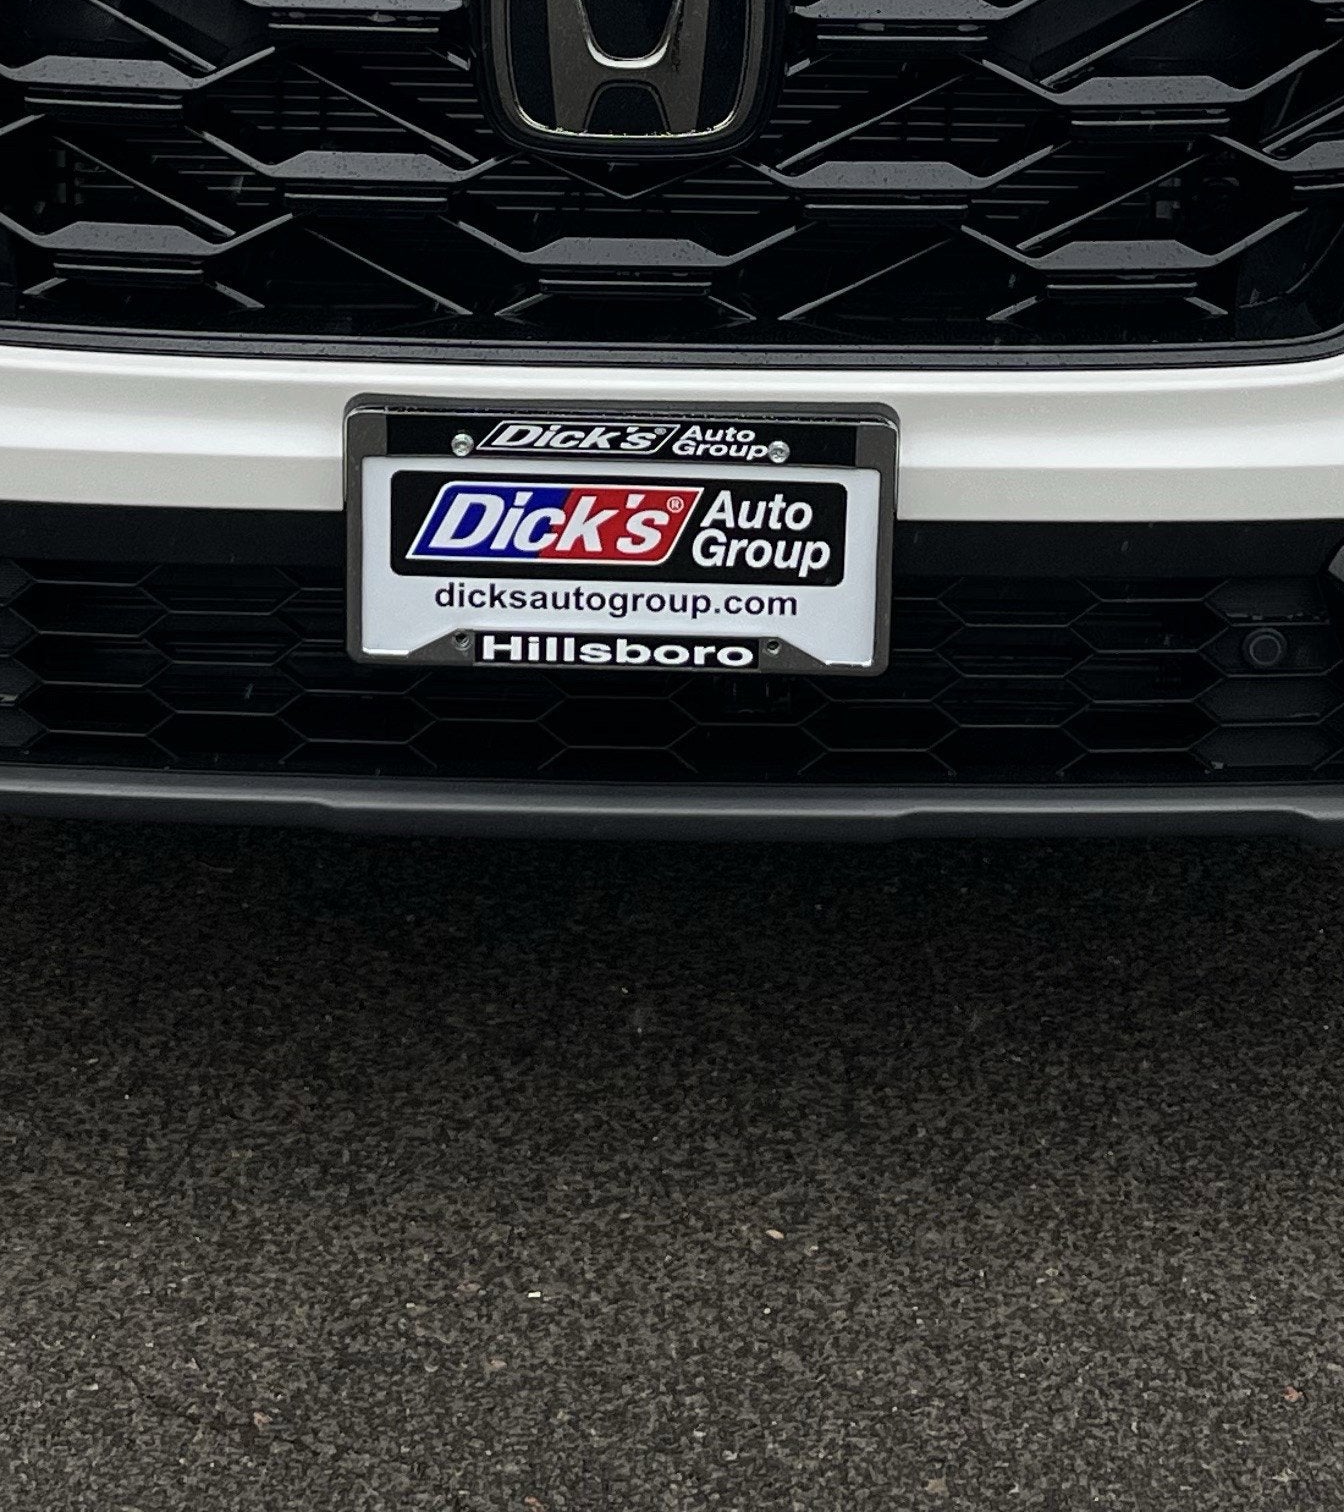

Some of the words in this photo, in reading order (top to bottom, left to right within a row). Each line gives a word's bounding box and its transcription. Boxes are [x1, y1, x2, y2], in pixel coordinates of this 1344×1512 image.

[671, 440, 768, 460] Group
[680, 425, 756, 442] Auto
[701, 490, 813, 531] Auto
[693, 530, 831, 577] Group
[434, 583, 798, 618] dicksautogroup.com
[482, 636, 754, 668] Hillsboro
